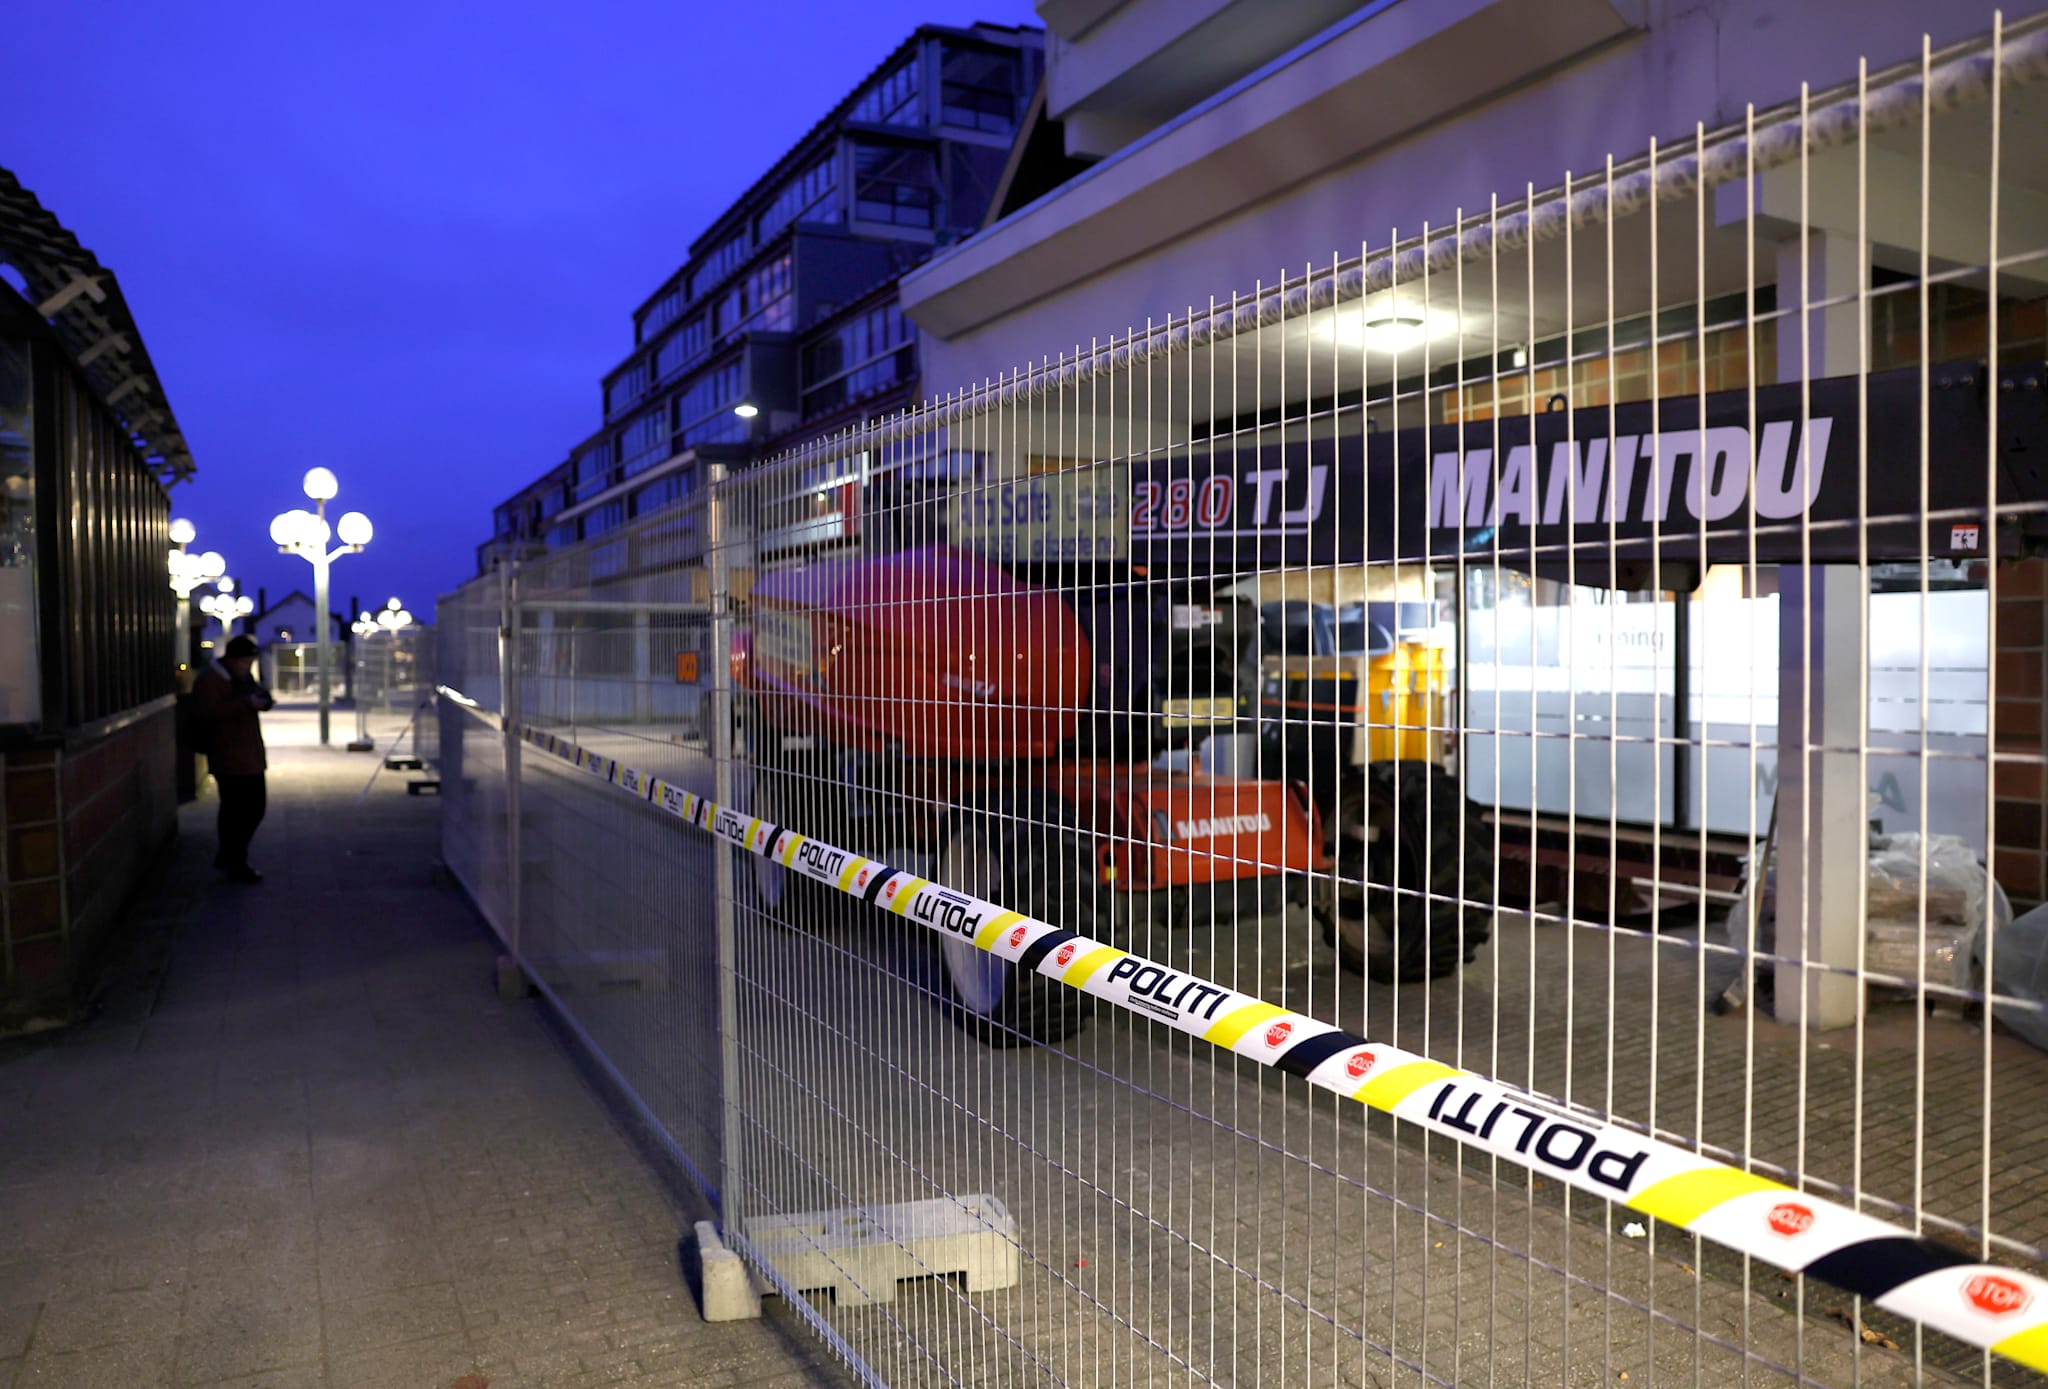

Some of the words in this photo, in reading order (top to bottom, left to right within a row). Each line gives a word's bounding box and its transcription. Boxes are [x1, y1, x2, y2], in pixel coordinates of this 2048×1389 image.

[1427, 416, 1833, 528] MANITOU
[1132, 475, 1233, 531] 280
[1245, 465, 1328, 525] TJ
[715, 813, 744, 842] POLITI
[1177, 813, 1272, 839] MANITOU
[799, 841, 844, 876] POLITI
[914, 892, 982, 939] POLITI
[1107, 957, 1230, 1020] POLITI
[1267, 1025, 1292, 1041] STOP
[1428, 1083, 1649, 1192] POLITI
[1770, 1206, 1815, 1230] STOP
[1965, 1276, 2030, 1308] STOP
